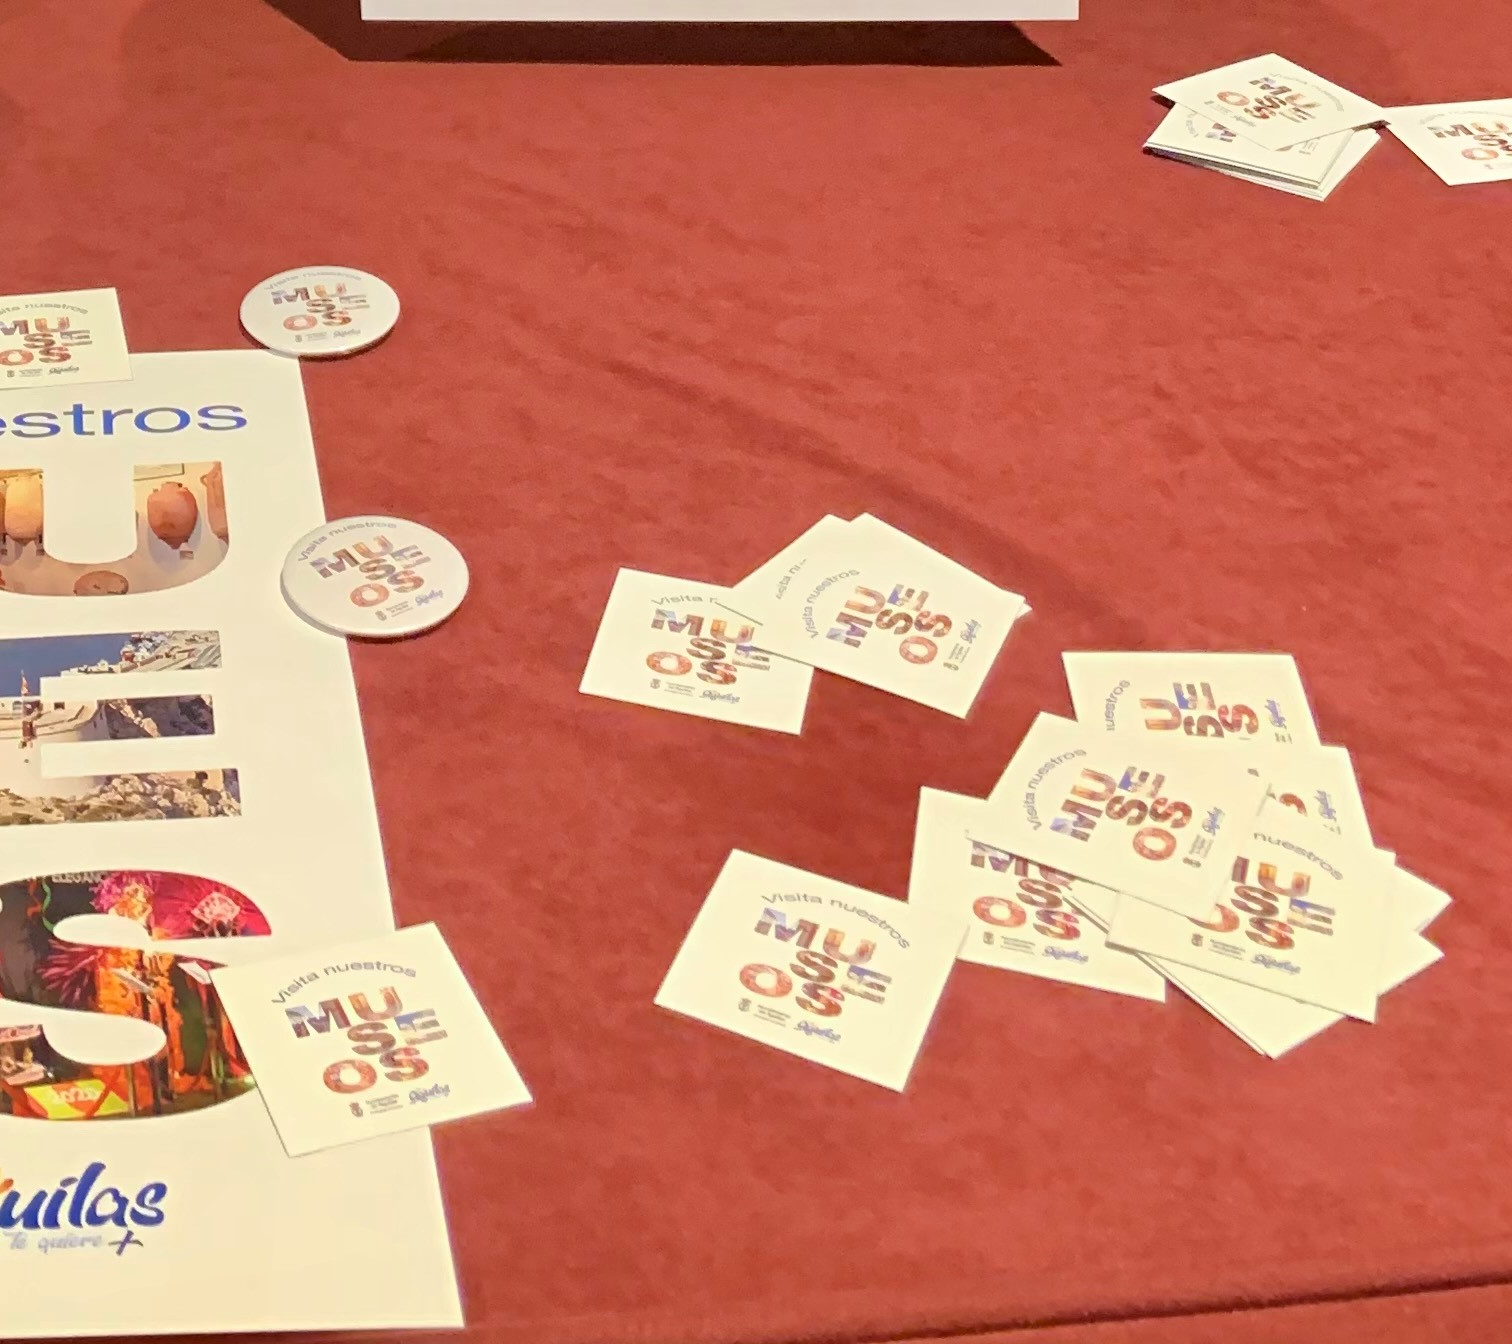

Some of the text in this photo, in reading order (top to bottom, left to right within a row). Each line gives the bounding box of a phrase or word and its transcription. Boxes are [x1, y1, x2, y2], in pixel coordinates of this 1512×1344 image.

[806, 569, 860, 604] nuestros
[1027, 748, 1087, 789] nuestros
[1254, 832, 1343, 881] nuestros
[761, 893, 910, 950] Visita nuestros
[271, 961, 416, 1005] Visita nuestros
